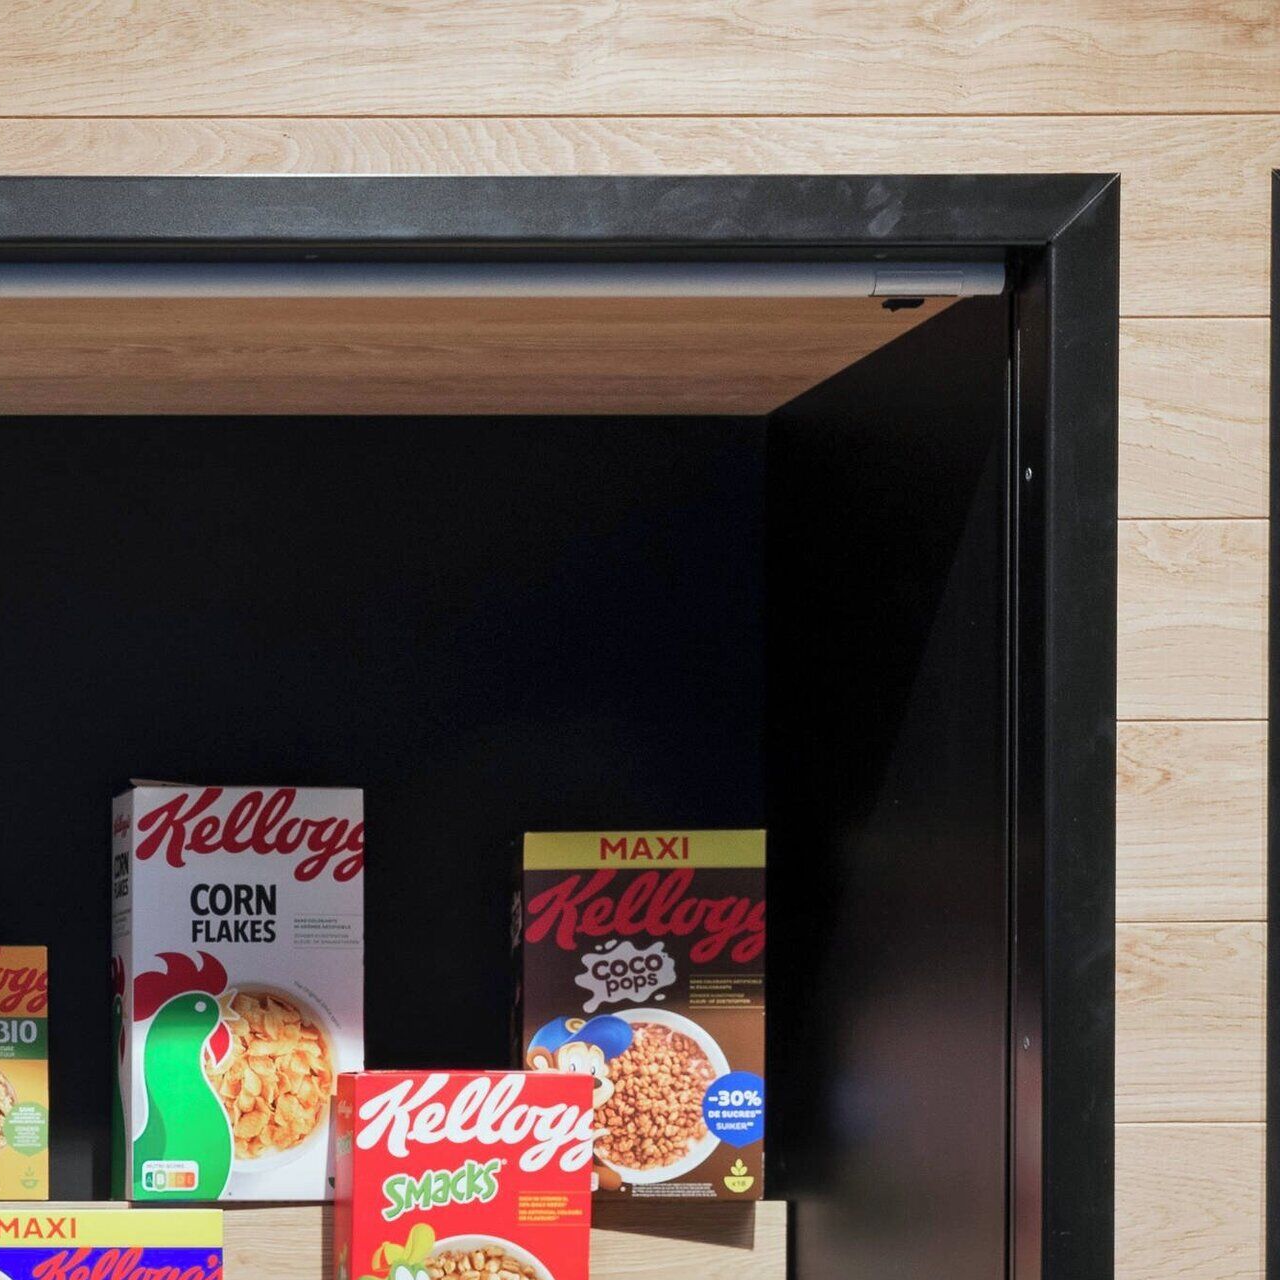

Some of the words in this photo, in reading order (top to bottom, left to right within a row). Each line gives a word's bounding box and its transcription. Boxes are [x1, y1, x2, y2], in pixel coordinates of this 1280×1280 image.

[600, 837, 690, 860] MAXI
[190, 884, 277, 916] CORN
[192, 920, 276, 943] FLAKES
[605, 973, 658, 997] pops
[708, 1090, 762, 1107] -30%
[708, 1110, 720, 1118] DE
